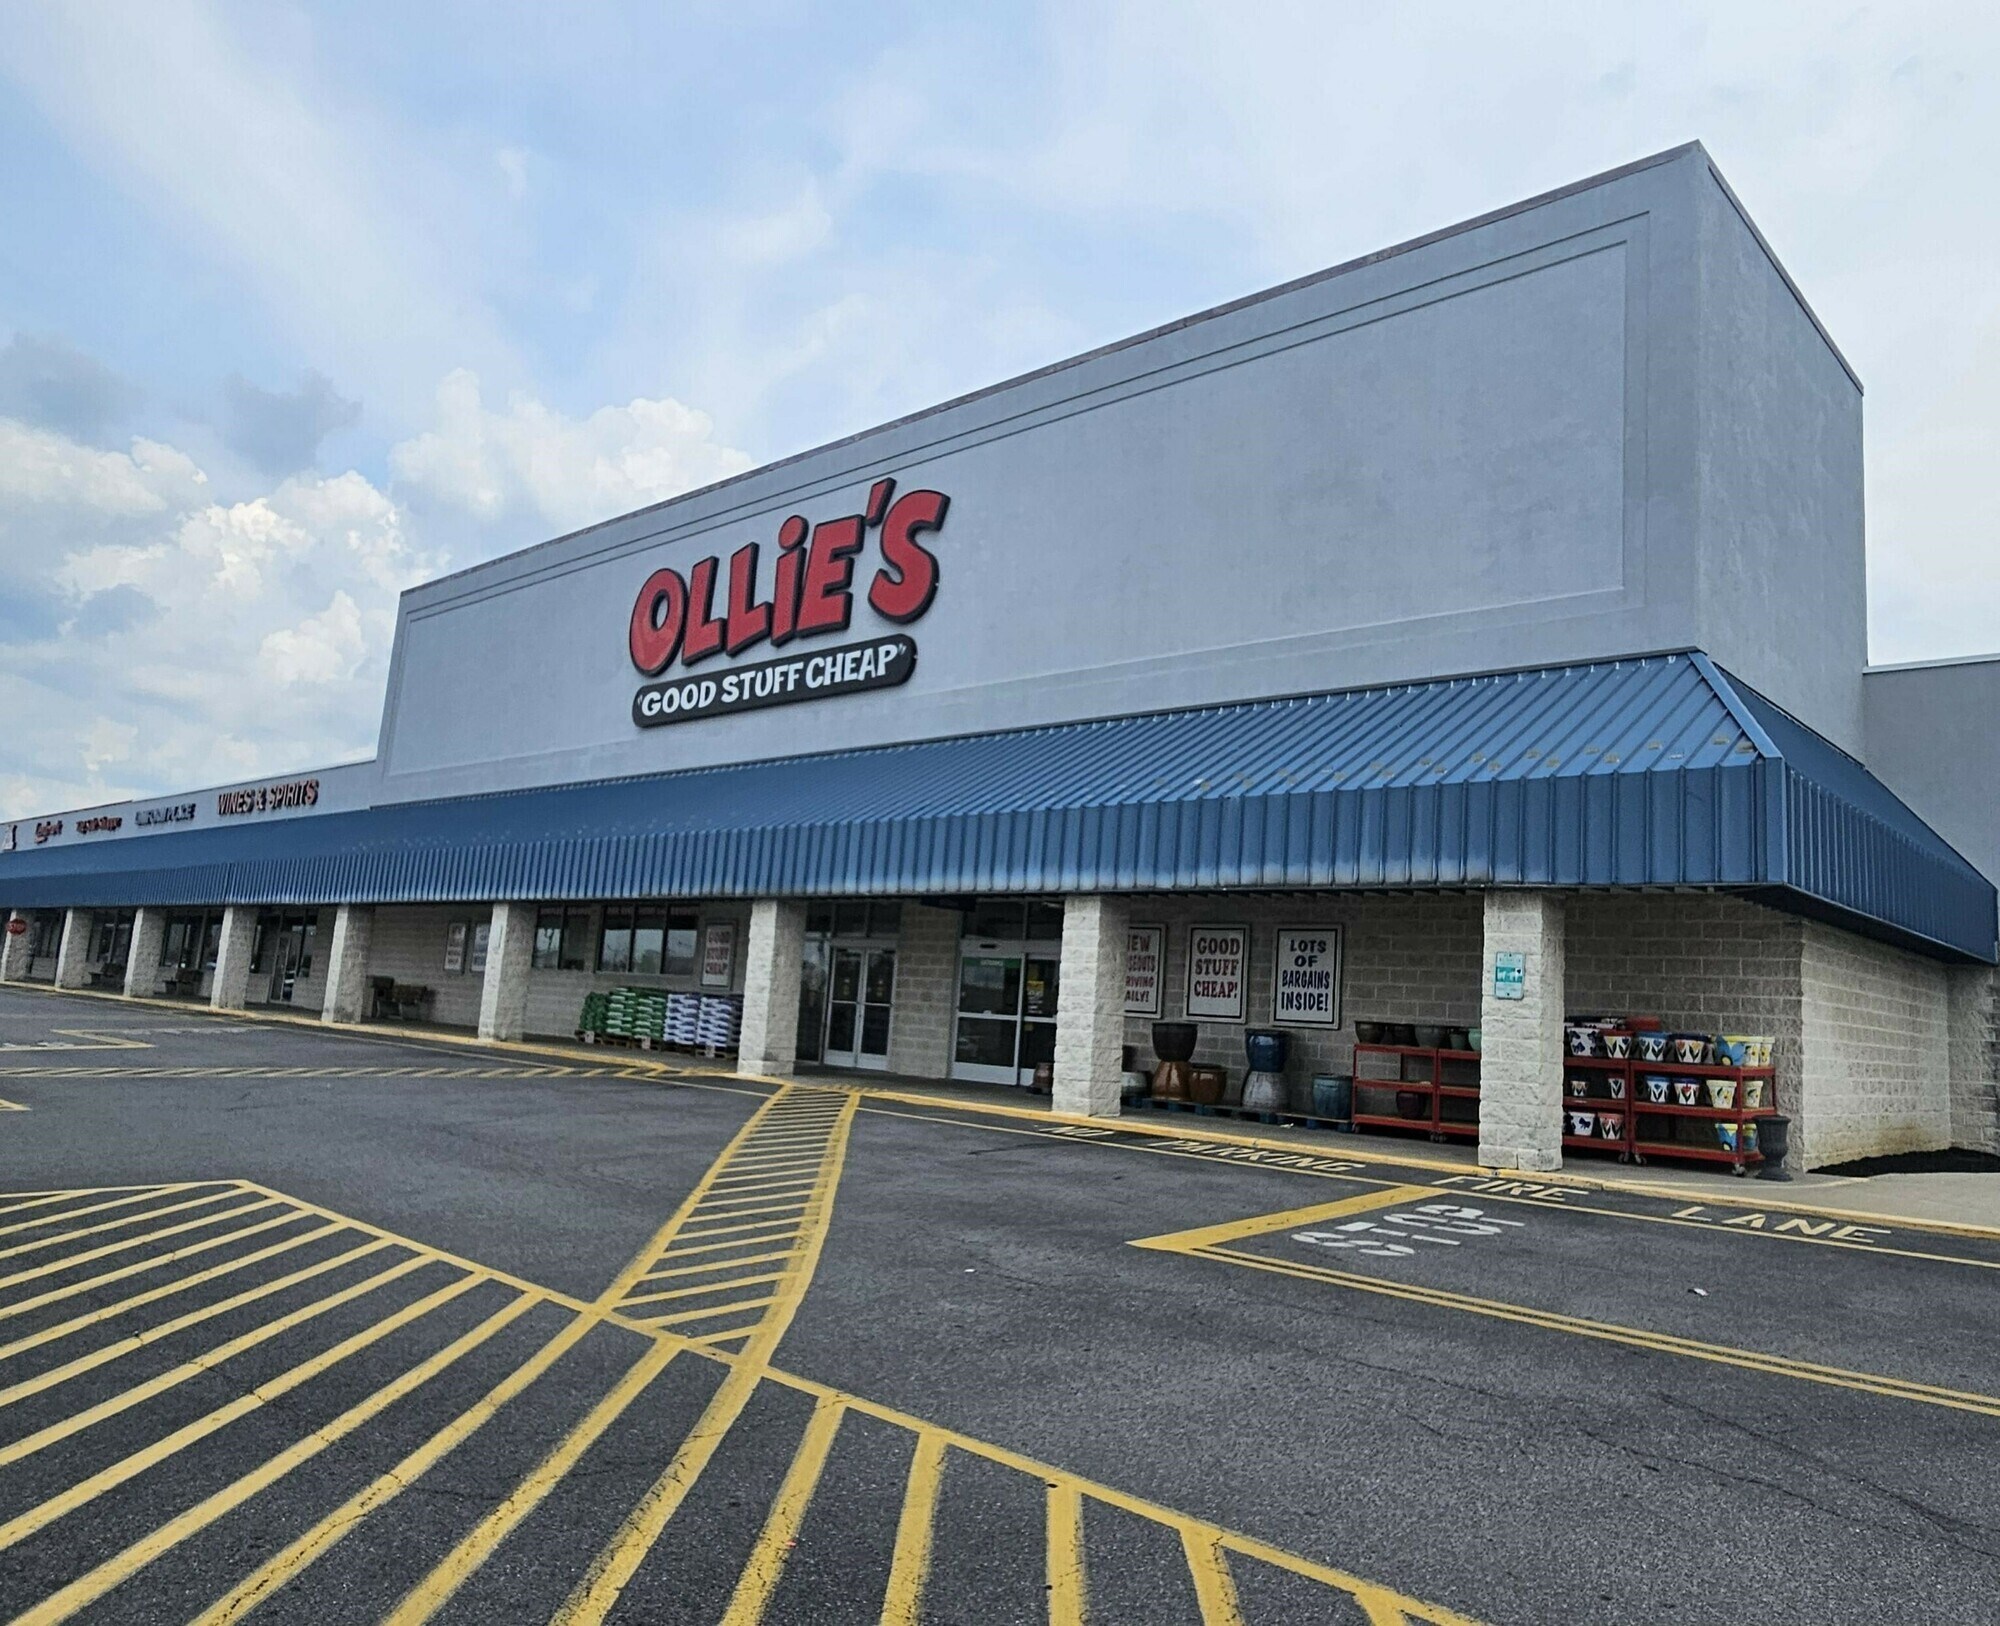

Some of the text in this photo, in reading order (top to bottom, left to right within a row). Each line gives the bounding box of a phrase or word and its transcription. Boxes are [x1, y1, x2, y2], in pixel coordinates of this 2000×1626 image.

[720, 662, 804, 702] STUFF
[217, 786, 256, 815] WINES
[255, 787, 267, 811] &
[269, 779, 319, 811] SPIRITS
[1197, 936, 1241, 956] GOOD
[1290, 939, 1327, 954] LOTS
[1195, 957, 1239, 977] STUFF
[1294, 954, 1318, 968] OF
[1125, 975, 1154, 988] RIVING
[1194, 979, 1238, 999] CHEAP!
[1282, 969, 1330, 991] BARGAINS
[1125, 990, 1150, 1003] AILY!
[1281, 990, 1329, 1013] INSIDE!
[1147, 1139, 1366, 1172] PARKING
[1431, 1175, 1589, 1202] FIRE
[1671, 1205, 1892, 1244] LANE
